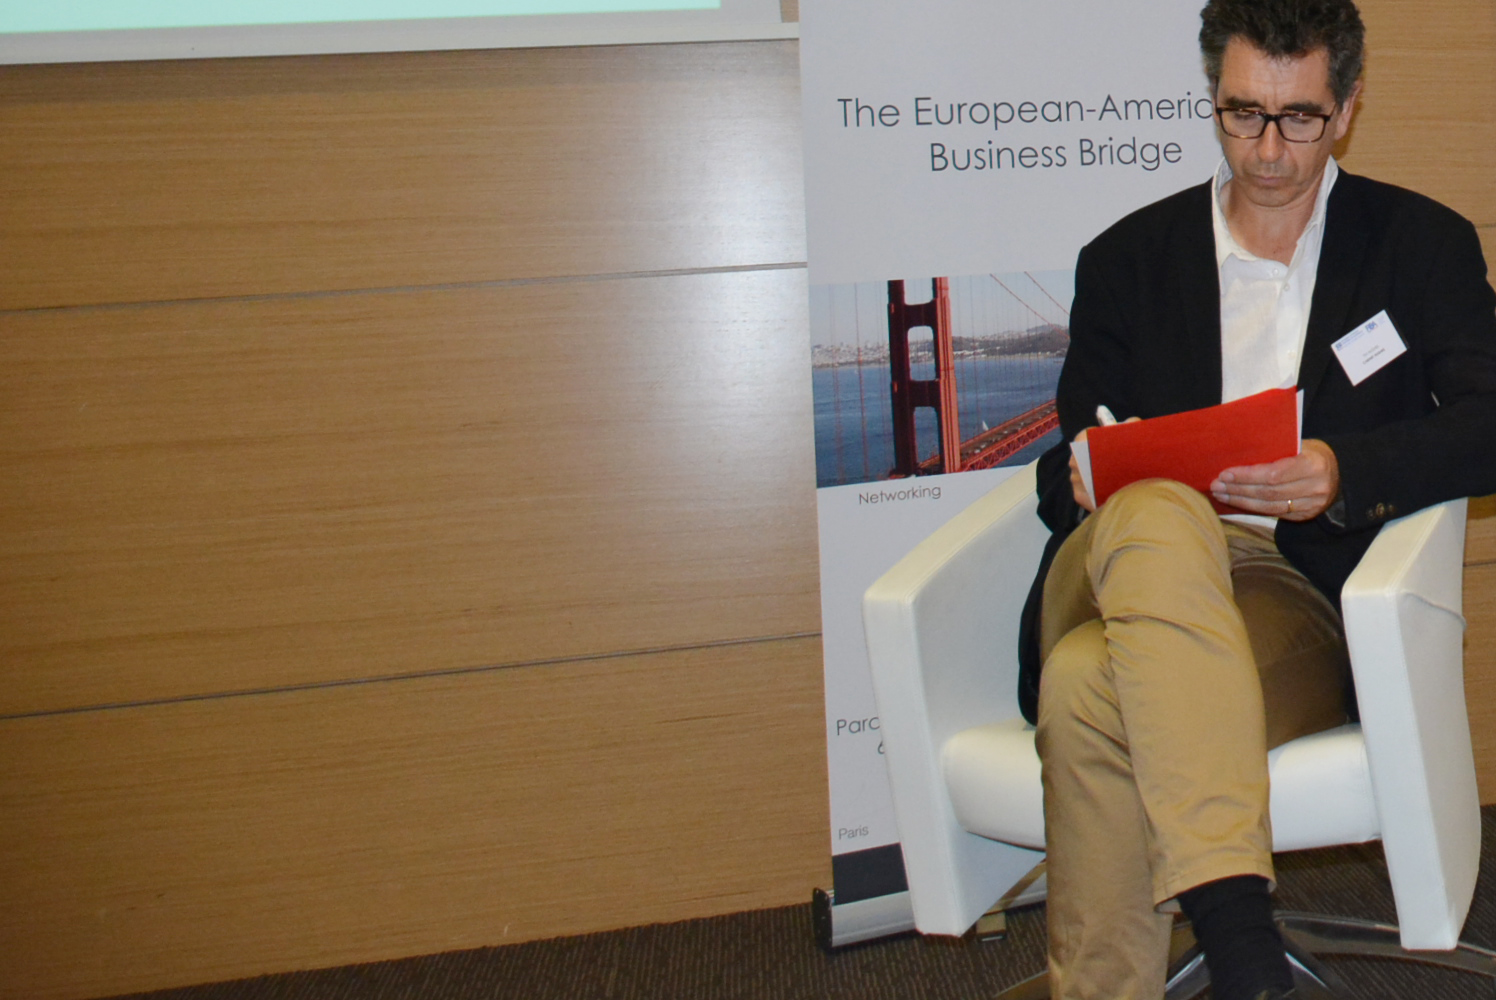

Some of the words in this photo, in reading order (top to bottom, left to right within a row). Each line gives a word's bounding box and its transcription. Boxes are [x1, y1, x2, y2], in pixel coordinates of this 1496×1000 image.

[837, 97, 900, 128] The
[914, 90, 1213, 131] European-Americ
[930, 139, 1067, 171] Business
[1079, 136, 1183, 171] Bridge
[858, 484, 942, 506] Networking
[838, 824, 870, 841] Paris
